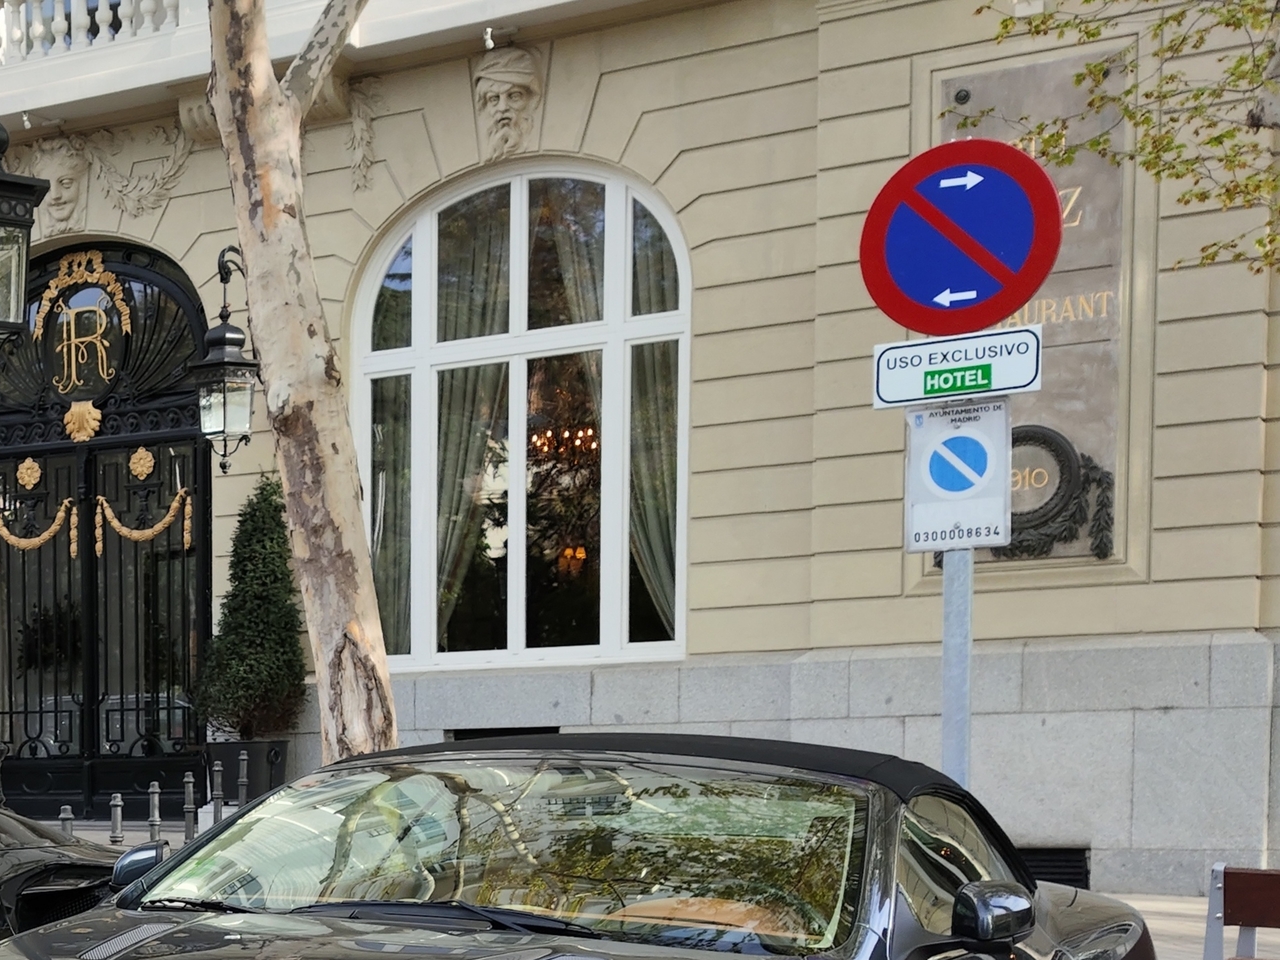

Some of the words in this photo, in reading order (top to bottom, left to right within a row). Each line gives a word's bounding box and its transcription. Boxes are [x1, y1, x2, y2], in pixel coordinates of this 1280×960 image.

[886, 354, 923, 371] USO
[928, 341, 1030, 365] EXCLUSIVO
[925, 369, 989, 391] HOTEL
[928, 405, 991, 418] AYUNTAMIENTO
[950, 415, 981, 424] MADRID
[1011, 466, 1049, 491] 910
[914, 525, 1000, 543] 0300008634
